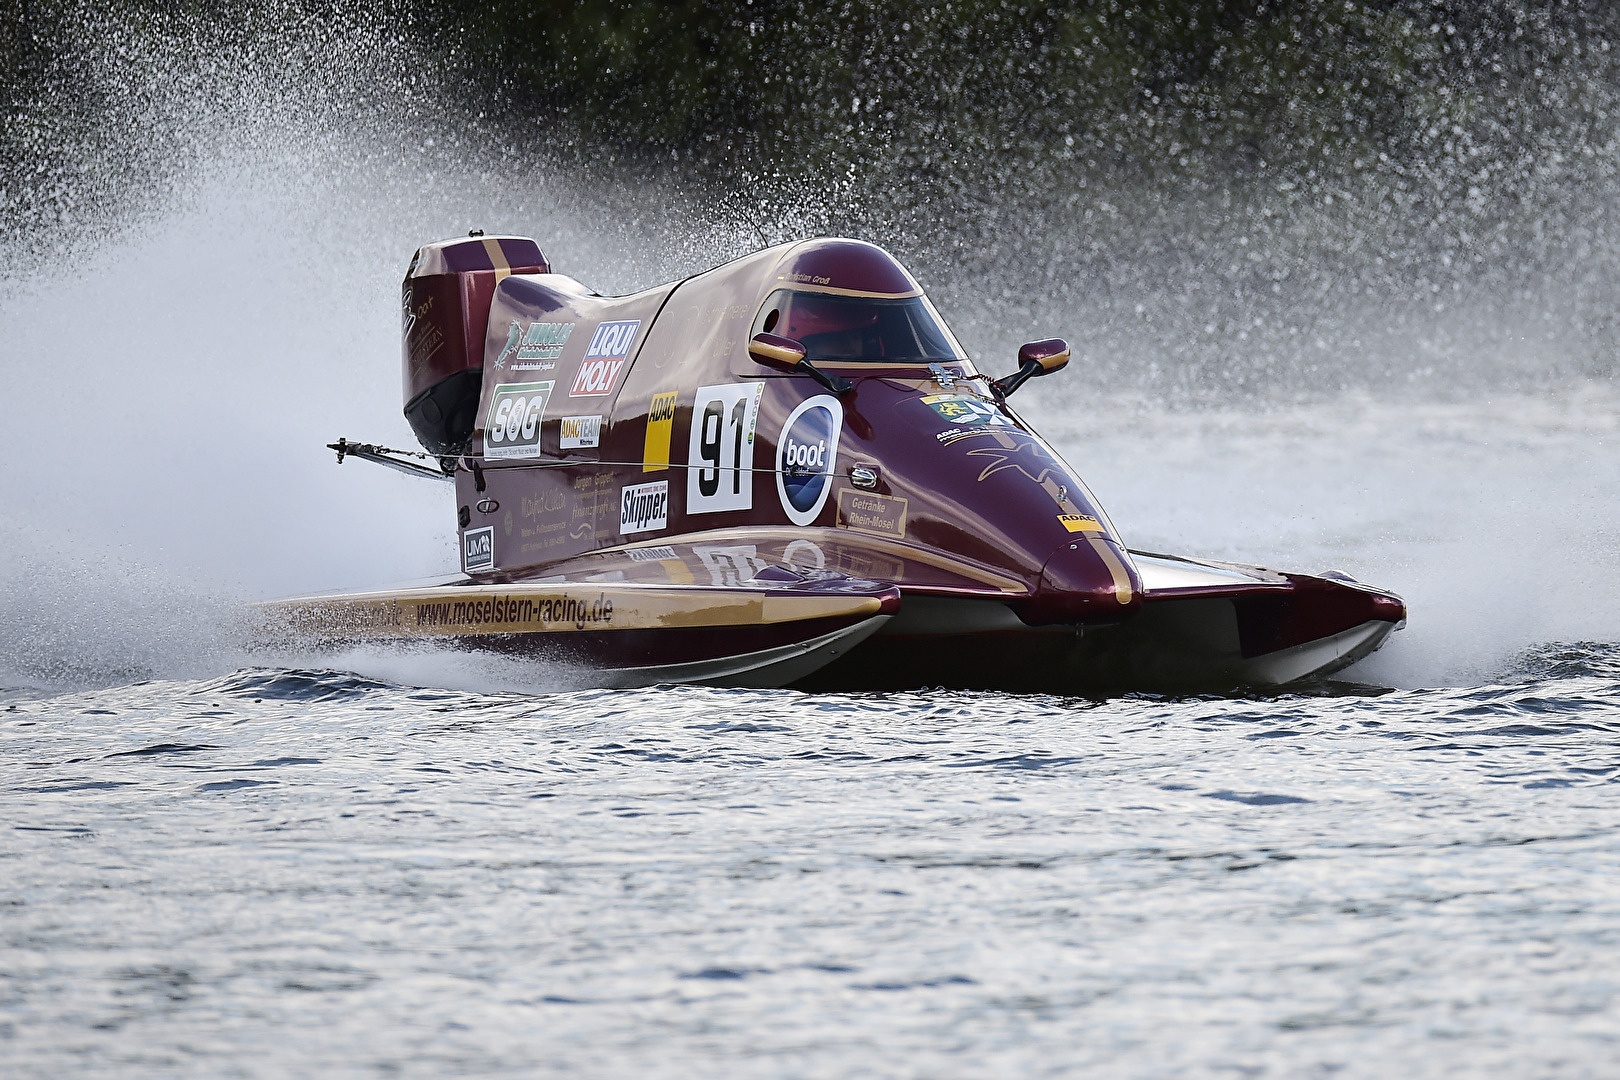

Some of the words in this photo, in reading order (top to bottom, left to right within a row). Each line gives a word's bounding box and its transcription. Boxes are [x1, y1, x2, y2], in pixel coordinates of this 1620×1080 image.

[587, 323, 635, 358] LIQUI
[573, 360, 621, 395] MOLY
[491, 395, 543, 443] SOG
[648, 395, 675, 423] ADAC
[698, 397, 749, 497] 91
[936, 428, 961, 441] ADAC
[786, 438, 825, 467] boot
[622, 488, 666, 529] Skipper.
[849, 512, 895, 529] Rhein-Mosel
[851, 497, 887, 513] Getränke
[1061, 514, 1096, 523] ADAC
[416, 592, 614, 630] www.moselstern-racing.de
